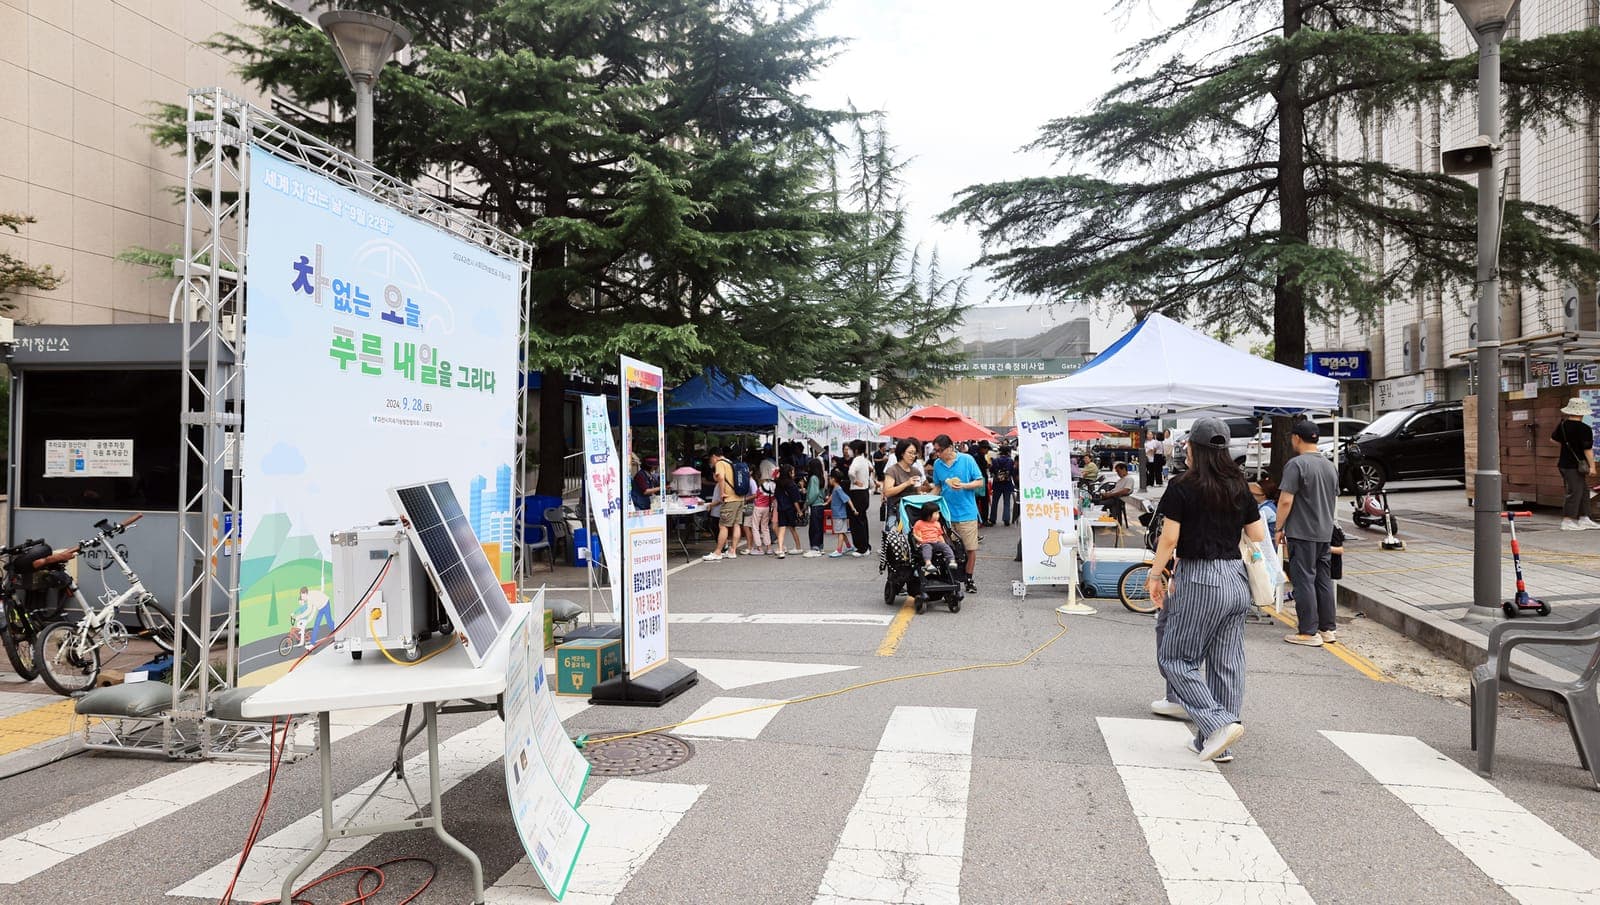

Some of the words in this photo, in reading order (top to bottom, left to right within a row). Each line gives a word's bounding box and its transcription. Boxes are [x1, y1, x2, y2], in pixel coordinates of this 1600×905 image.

[264, 169, 290, 194] 세계
[292, 179, 304, 200] 차
[307, 185, 329, 209] 없는
[331, 198, 342, 216] 날
[291, 243, 330, 305] 차
[331, 278, 373, 318] 없는
[381, 284, 425, 332] 오늘,
[329, 326, 384, 376] 푸른
[393, 342, 453, 388] 내일을
[456, 365, 497, 394] 그리다
[972, 362, 1045, 372] 주택재건축정비사업
[386, 398, 402, 410] 2024.
[1023, 485, 1045, 499] 나의
[1025, 502, 1070, 521] 주스만들기
[564, 657, 571, 668] 6
